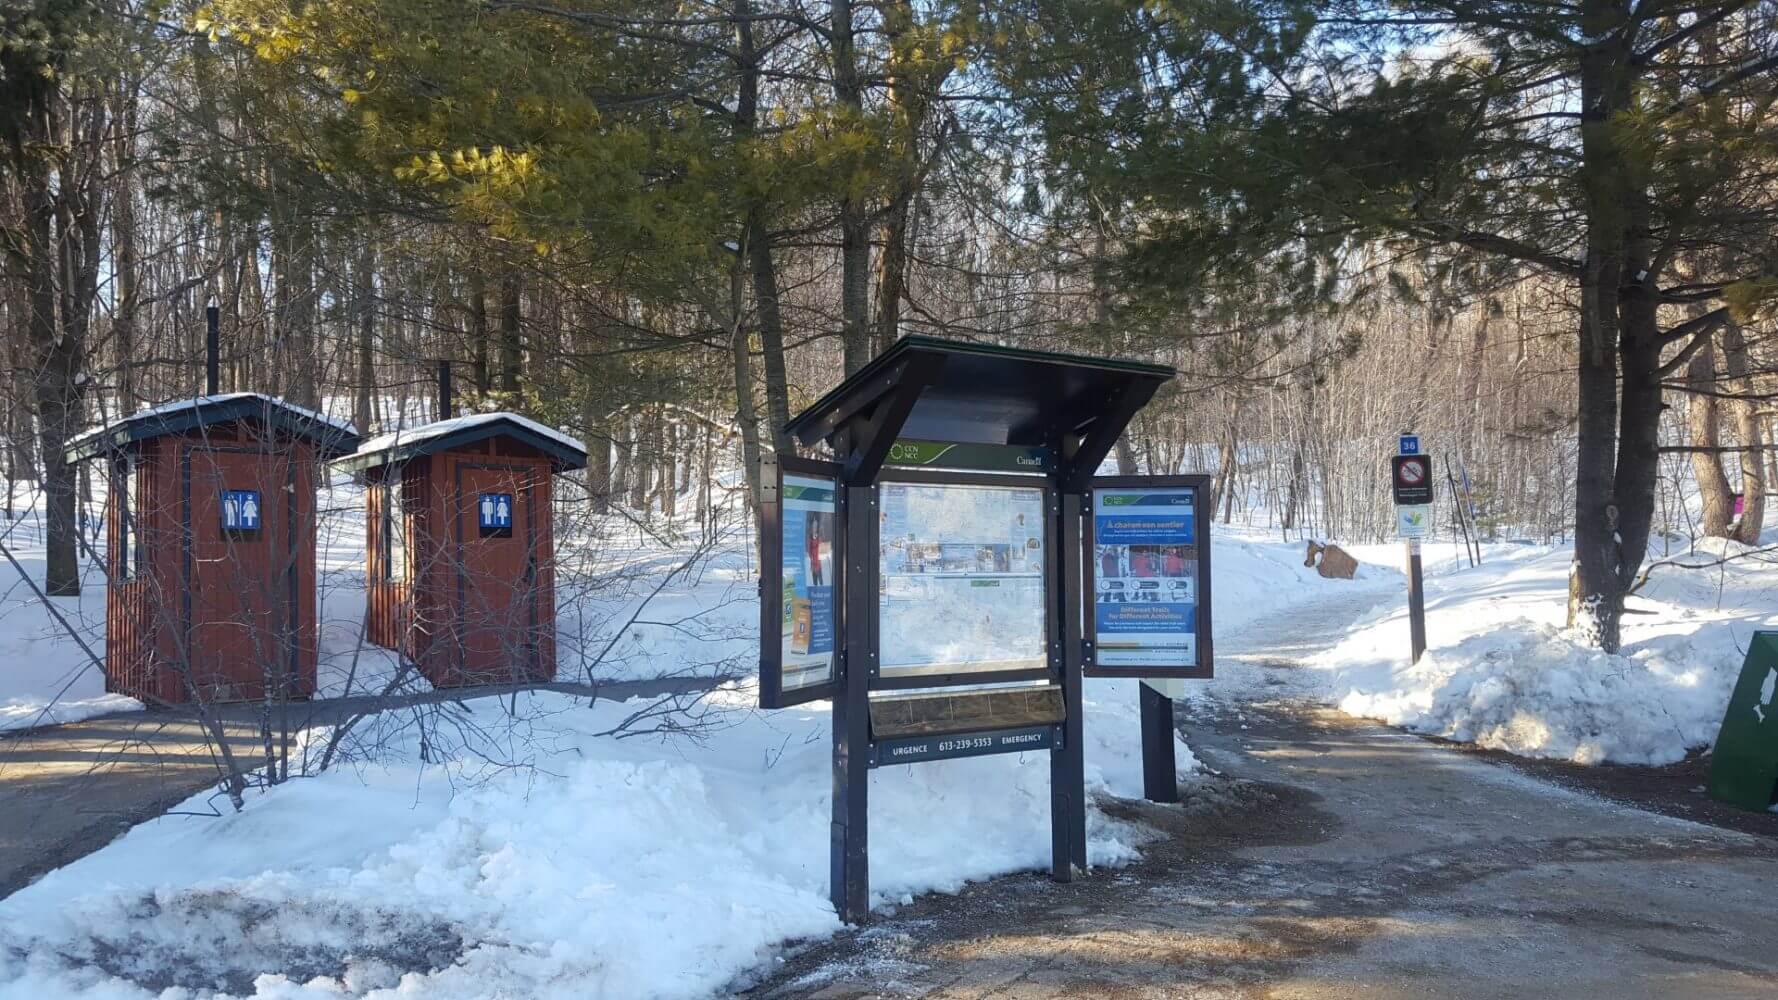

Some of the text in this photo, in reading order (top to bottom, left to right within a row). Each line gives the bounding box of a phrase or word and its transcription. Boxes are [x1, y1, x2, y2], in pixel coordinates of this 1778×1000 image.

[1404, 441, 1415, 450] 36
[1016, 455, 1042, 466] Canada
[893, 734, 1042, 756] URGENCE 613-239-5353 EMERGENCY
